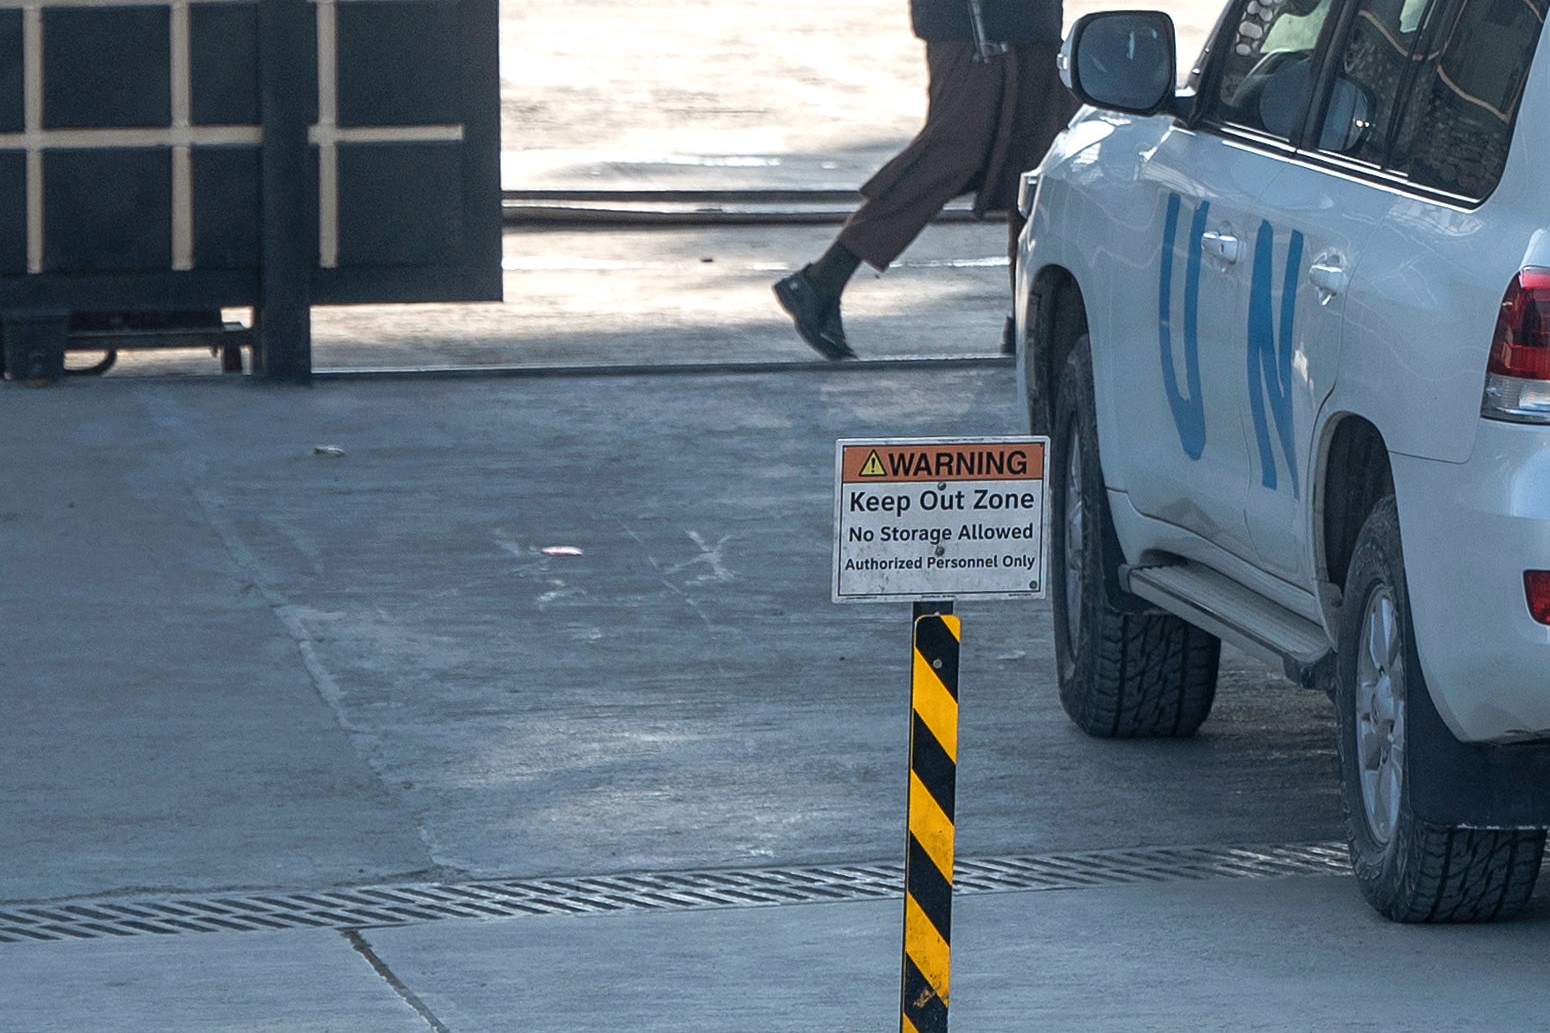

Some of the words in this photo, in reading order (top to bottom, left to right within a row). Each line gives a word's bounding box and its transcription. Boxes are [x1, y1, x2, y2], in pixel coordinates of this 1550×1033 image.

[1159, 192, 1304, 500] UN
[888, 451, 1027, 476] WARNING
[850, 491, 911, 517] Keep
[920, 490, 965, 511] Out
[973, 489, 1034, 509] Zone
[849, 527, 874, 542] No
[880, 526, 952, 545] Storage
[958, 523, 1033, 540] Allowed
[845, 558, 922, 571] Authorized
[927, 555, 998, 569] Personnel
[1003, 555, 1036, 570] Only
